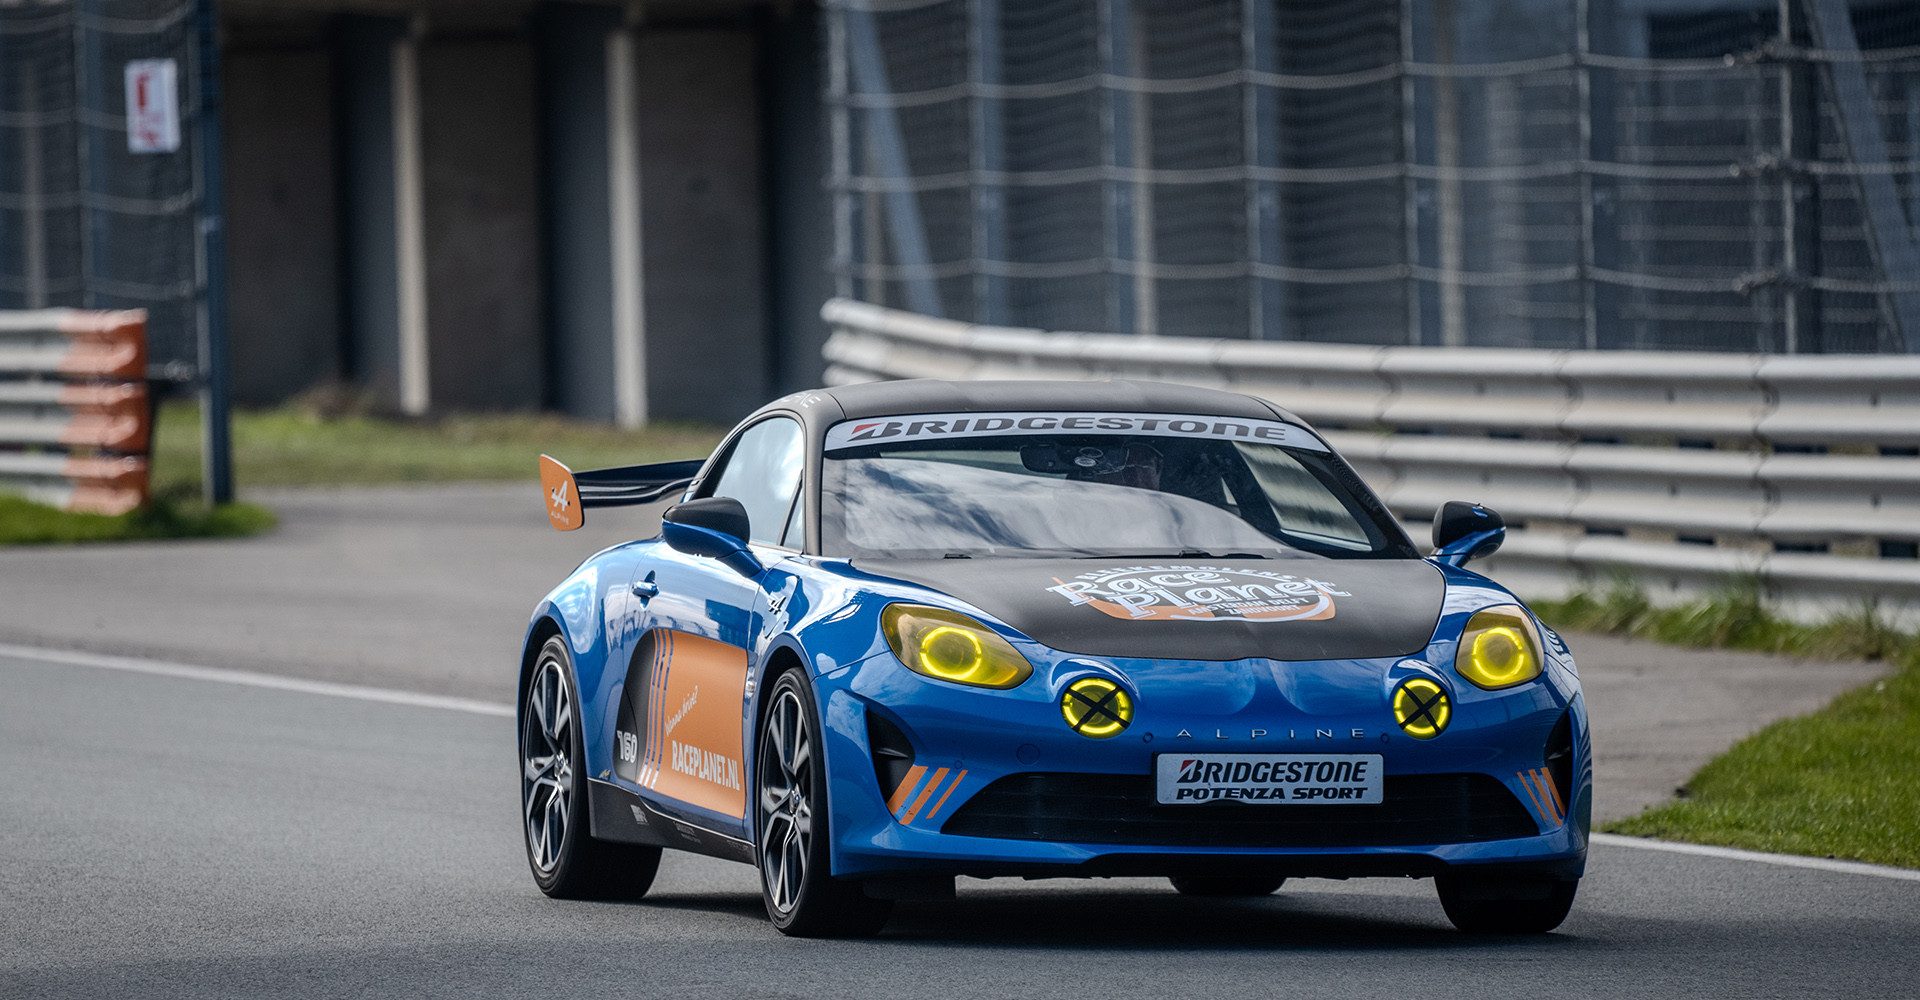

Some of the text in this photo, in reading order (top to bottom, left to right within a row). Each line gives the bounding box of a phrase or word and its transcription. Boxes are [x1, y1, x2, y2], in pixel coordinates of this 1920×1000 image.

[846, 417, 1287, 441] BRIDGESTONE
[1045, 570, 1232, 607] Race
[1105, 577, 1352, 618] Planet
[1176, 728, 1365, 739] ALPINE
[671, 739, 740, 791] RACEPLANET.NL
[1176, 759, 1369, 784] BRIDGESTONE
[1176, 787, 1368, 800] POTENZA SPORT
